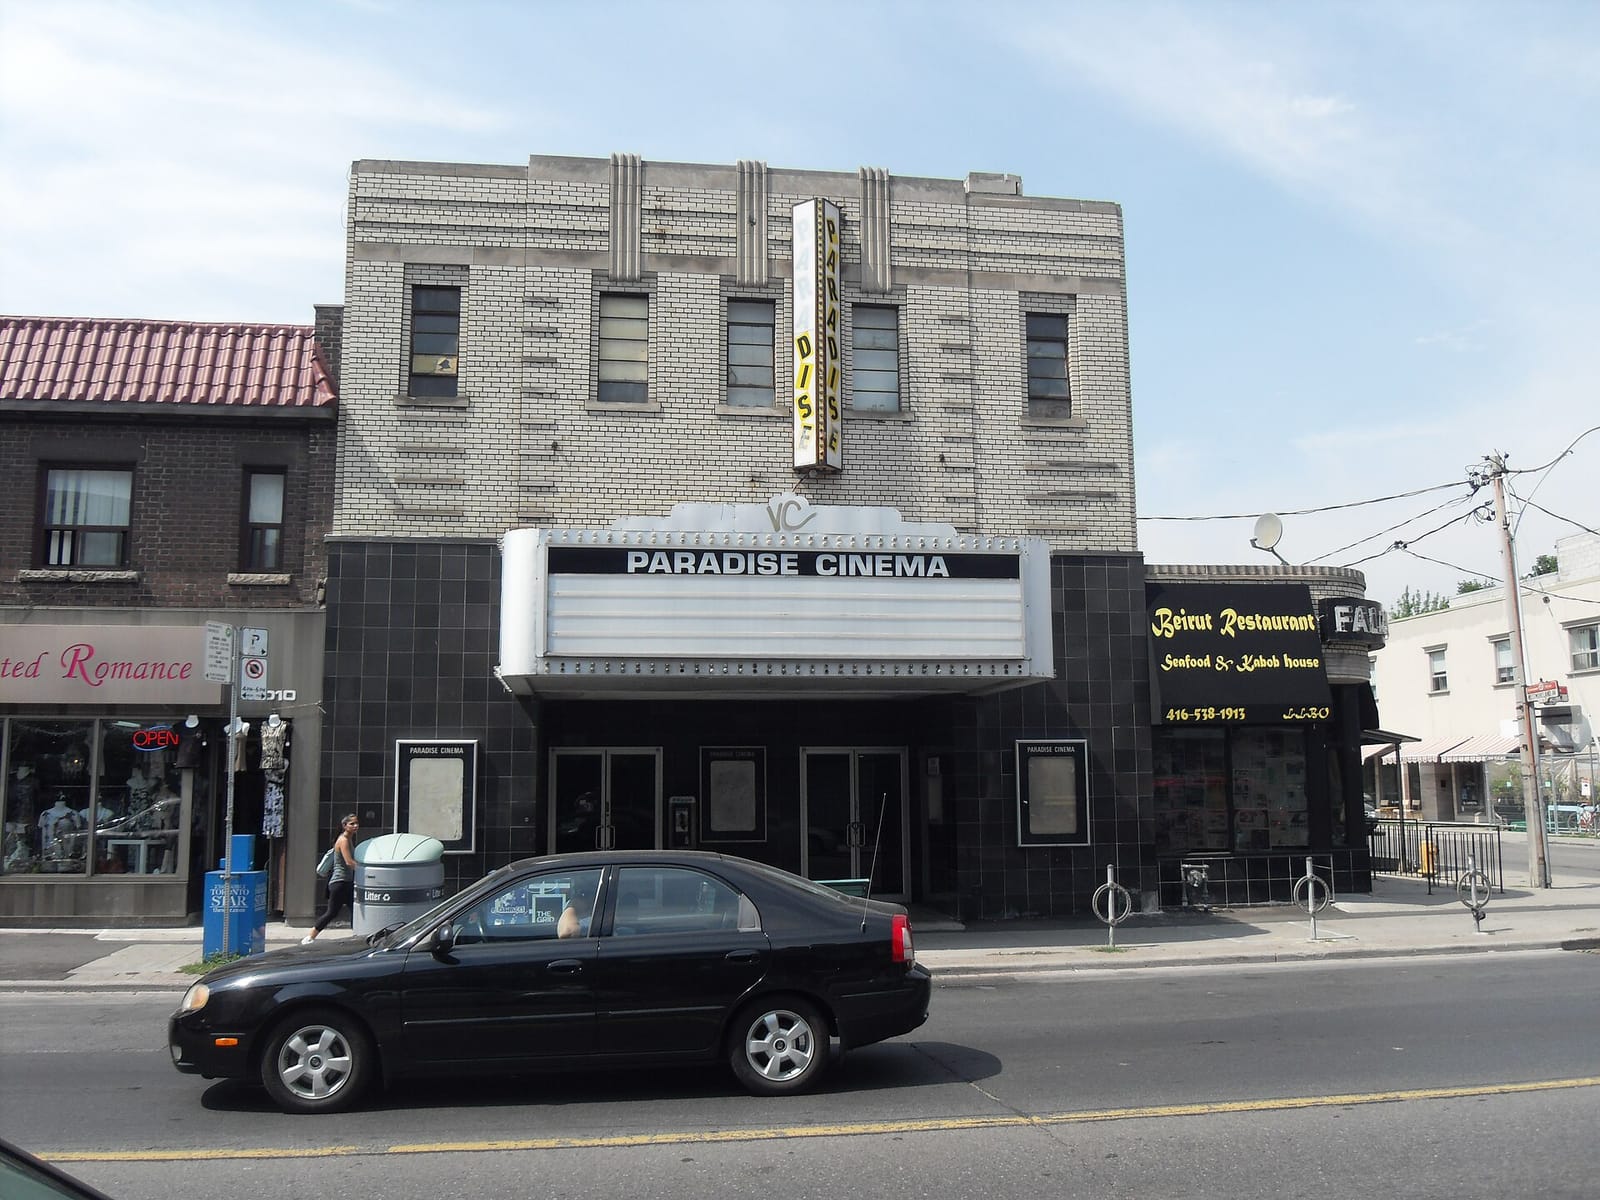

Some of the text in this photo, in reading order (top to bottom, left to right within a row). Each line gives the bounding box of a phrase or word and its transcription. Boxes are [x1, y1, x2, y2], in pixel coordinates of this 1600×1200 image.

[826, 218, 840, 452] PARADISE
[627, 551, 950, 578] PARADISE CINEMA
[1152, 607, 1316, 638] Beirut Restaurant
[1, 651, 49, 679] ted
[61, 643, 193, 687] Romance
[1160, 653, 1320, 672] Seafood & Kabob house
[1166, 706, 1247, 721] 416-538-1913
[132, 730, 180, 747] OPEN
[364, 890, 381, 901] Litter
